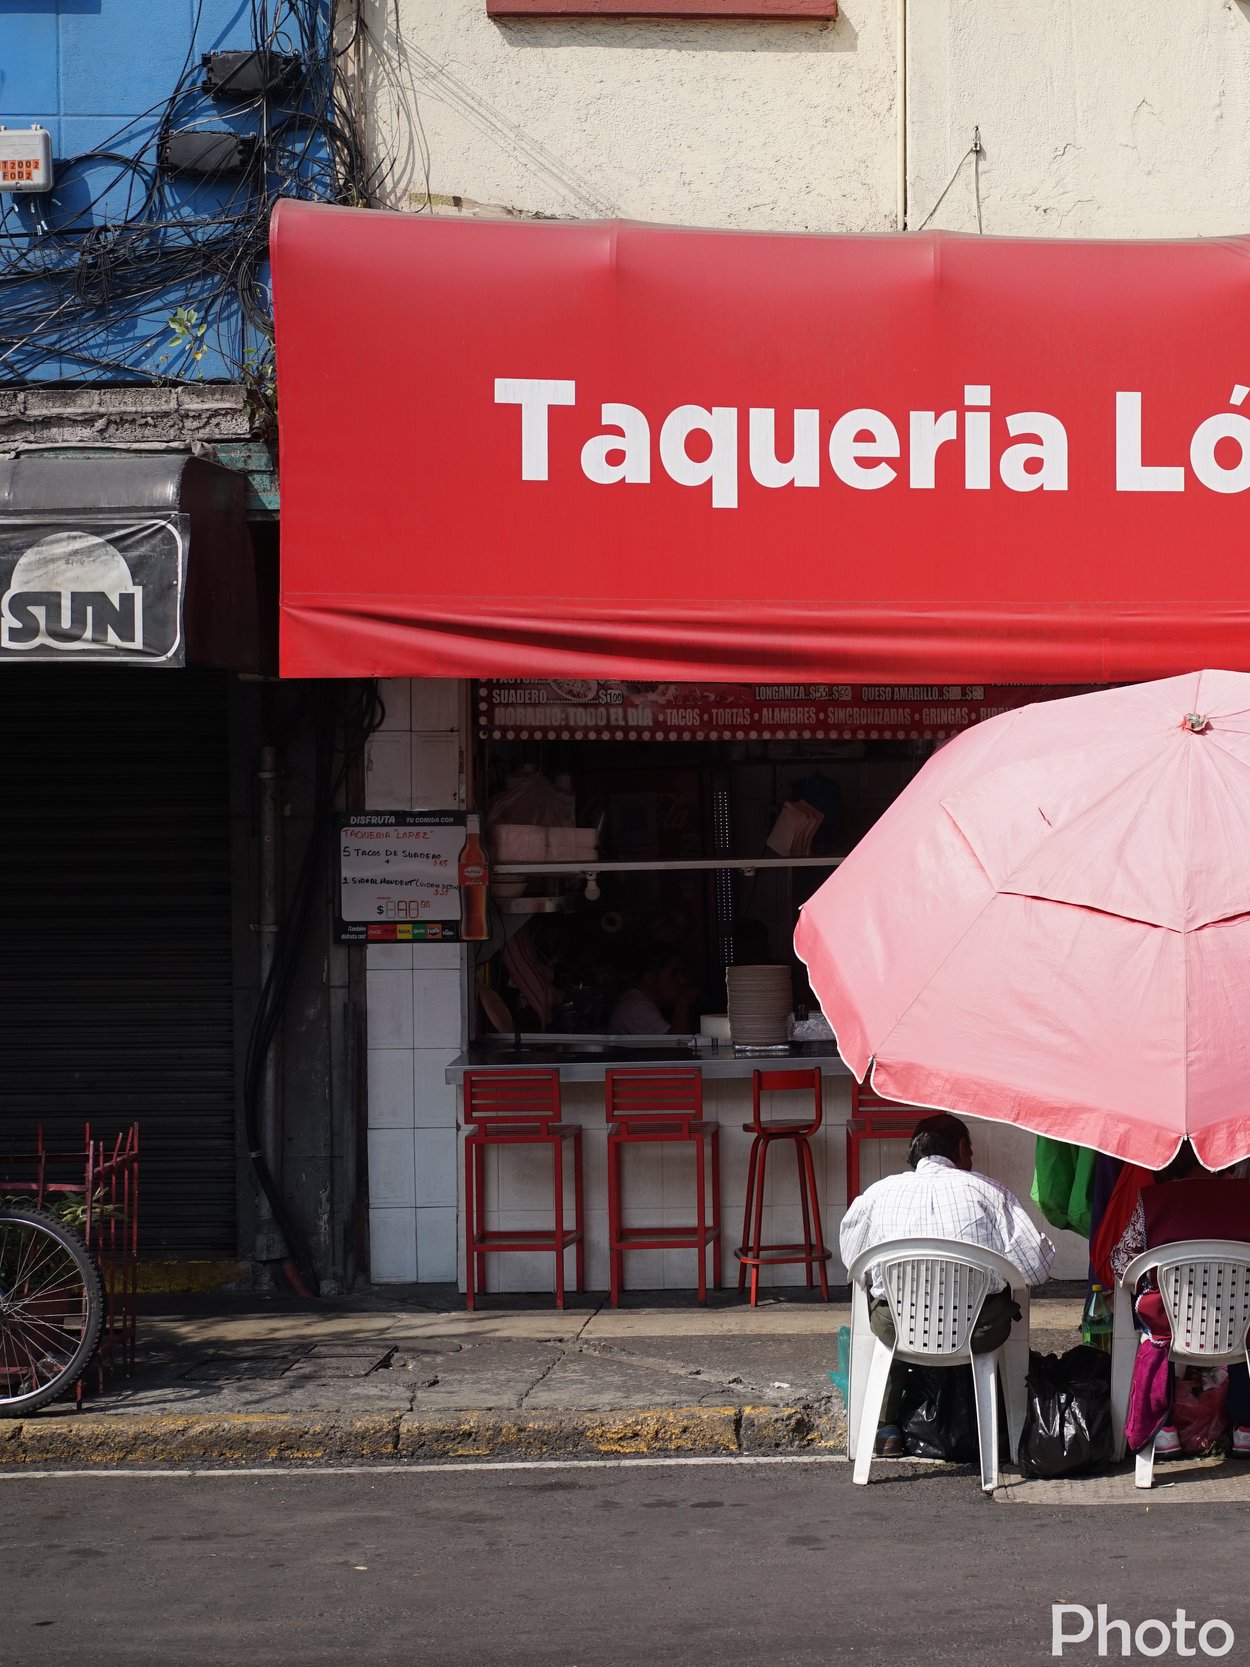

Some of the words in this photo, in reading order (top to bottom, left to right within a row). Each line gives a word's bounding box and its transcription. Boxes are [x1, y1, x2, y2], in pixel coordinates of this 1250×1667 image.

[494, 377, 1069, 509] Taqueria
[6, 589, 139, 646] SUN
[861, 686, 891, 702] QUESO
[568, 706, 607, 726] TODO
[609, 706, 625, 726] EL
[665, 708, 700, 726] TACOS
[711, 708, 751, 726] TORTAS
[761, 707, 817, 724] ALAMBRES
[827, 707, 911, 725] SINCRONIZADAS
[922, 708, 969, 725] GRINGAS
[350, 815, 396, 825] DISFRUTA
[342, 846, 351, 857] 5
[385, 849, 399, 857] DE
